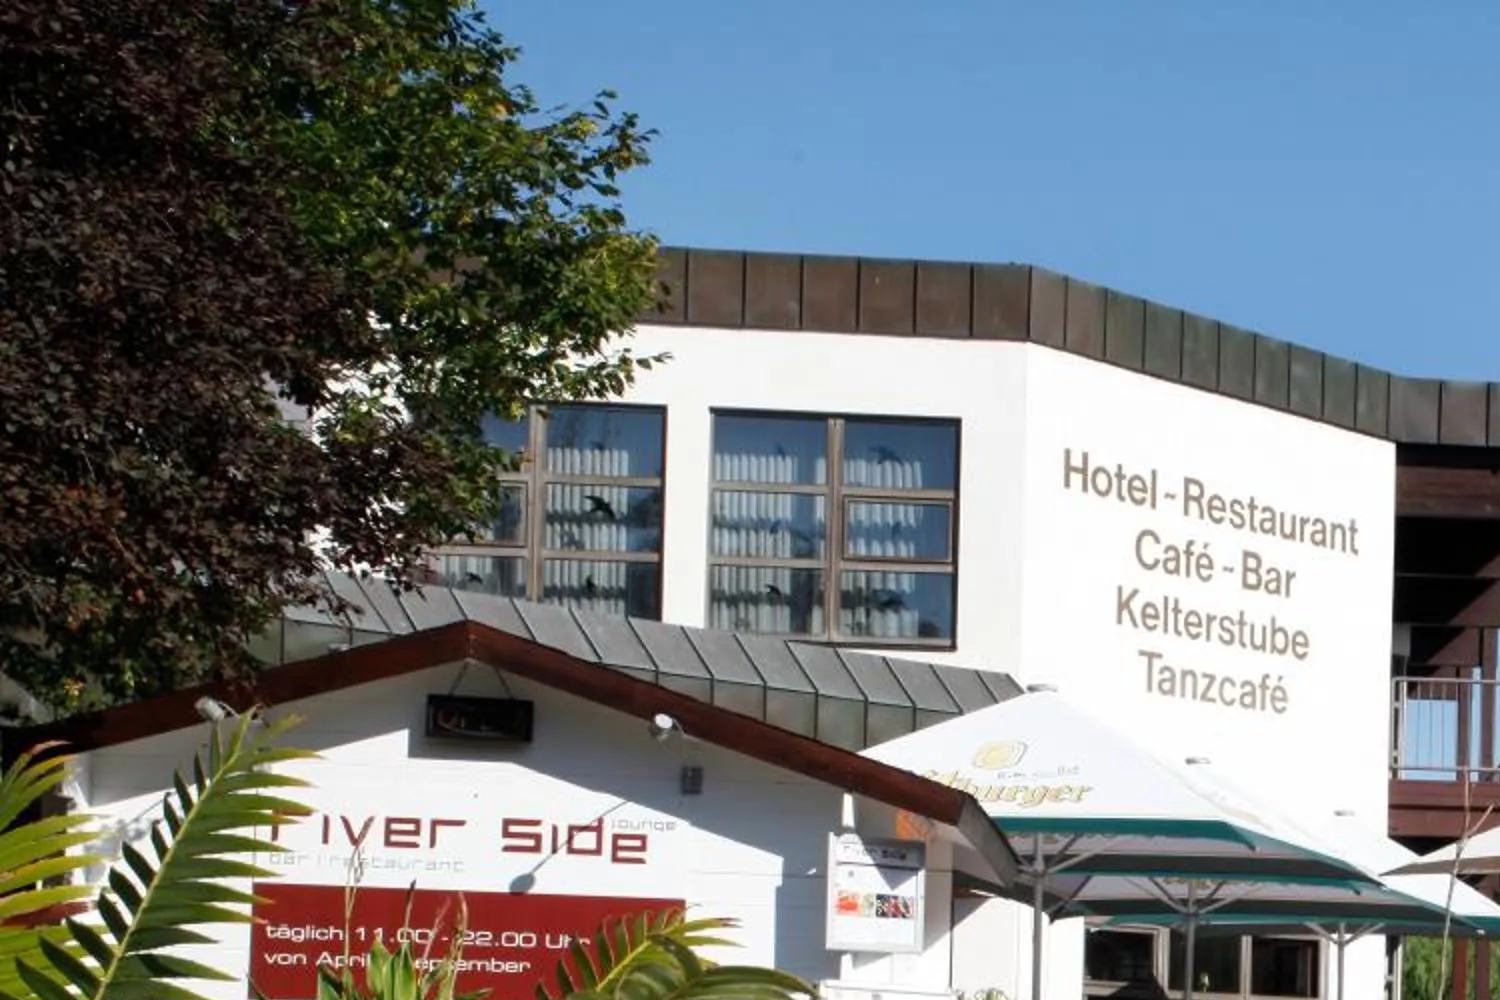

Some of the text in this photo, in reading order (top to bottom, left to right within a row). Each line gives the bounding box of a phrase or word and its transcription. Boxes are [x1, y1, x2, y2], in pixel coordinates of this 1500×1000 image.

[1063, 447, 1157, 510] Hotel
[1183, 476, 1359, 556] Restaurant
[1135, 529, 1214, 583] Café
[1241, 549, 1297, 598] Bar
[1116, 585, 1310, 661] Kelterstube
[1138, 649, 1288, 714] Tanzcafé
[271, 806, 648, 864] river side
[611, 819, 678, 832] lounge
[264, 953, 307, 966] von
[316, 951, 371, 968] April
[265, 924, 345, 943] täglich
[355, 926, 436, 944] 11.00
[461, 929, 537, 948] 22.00
